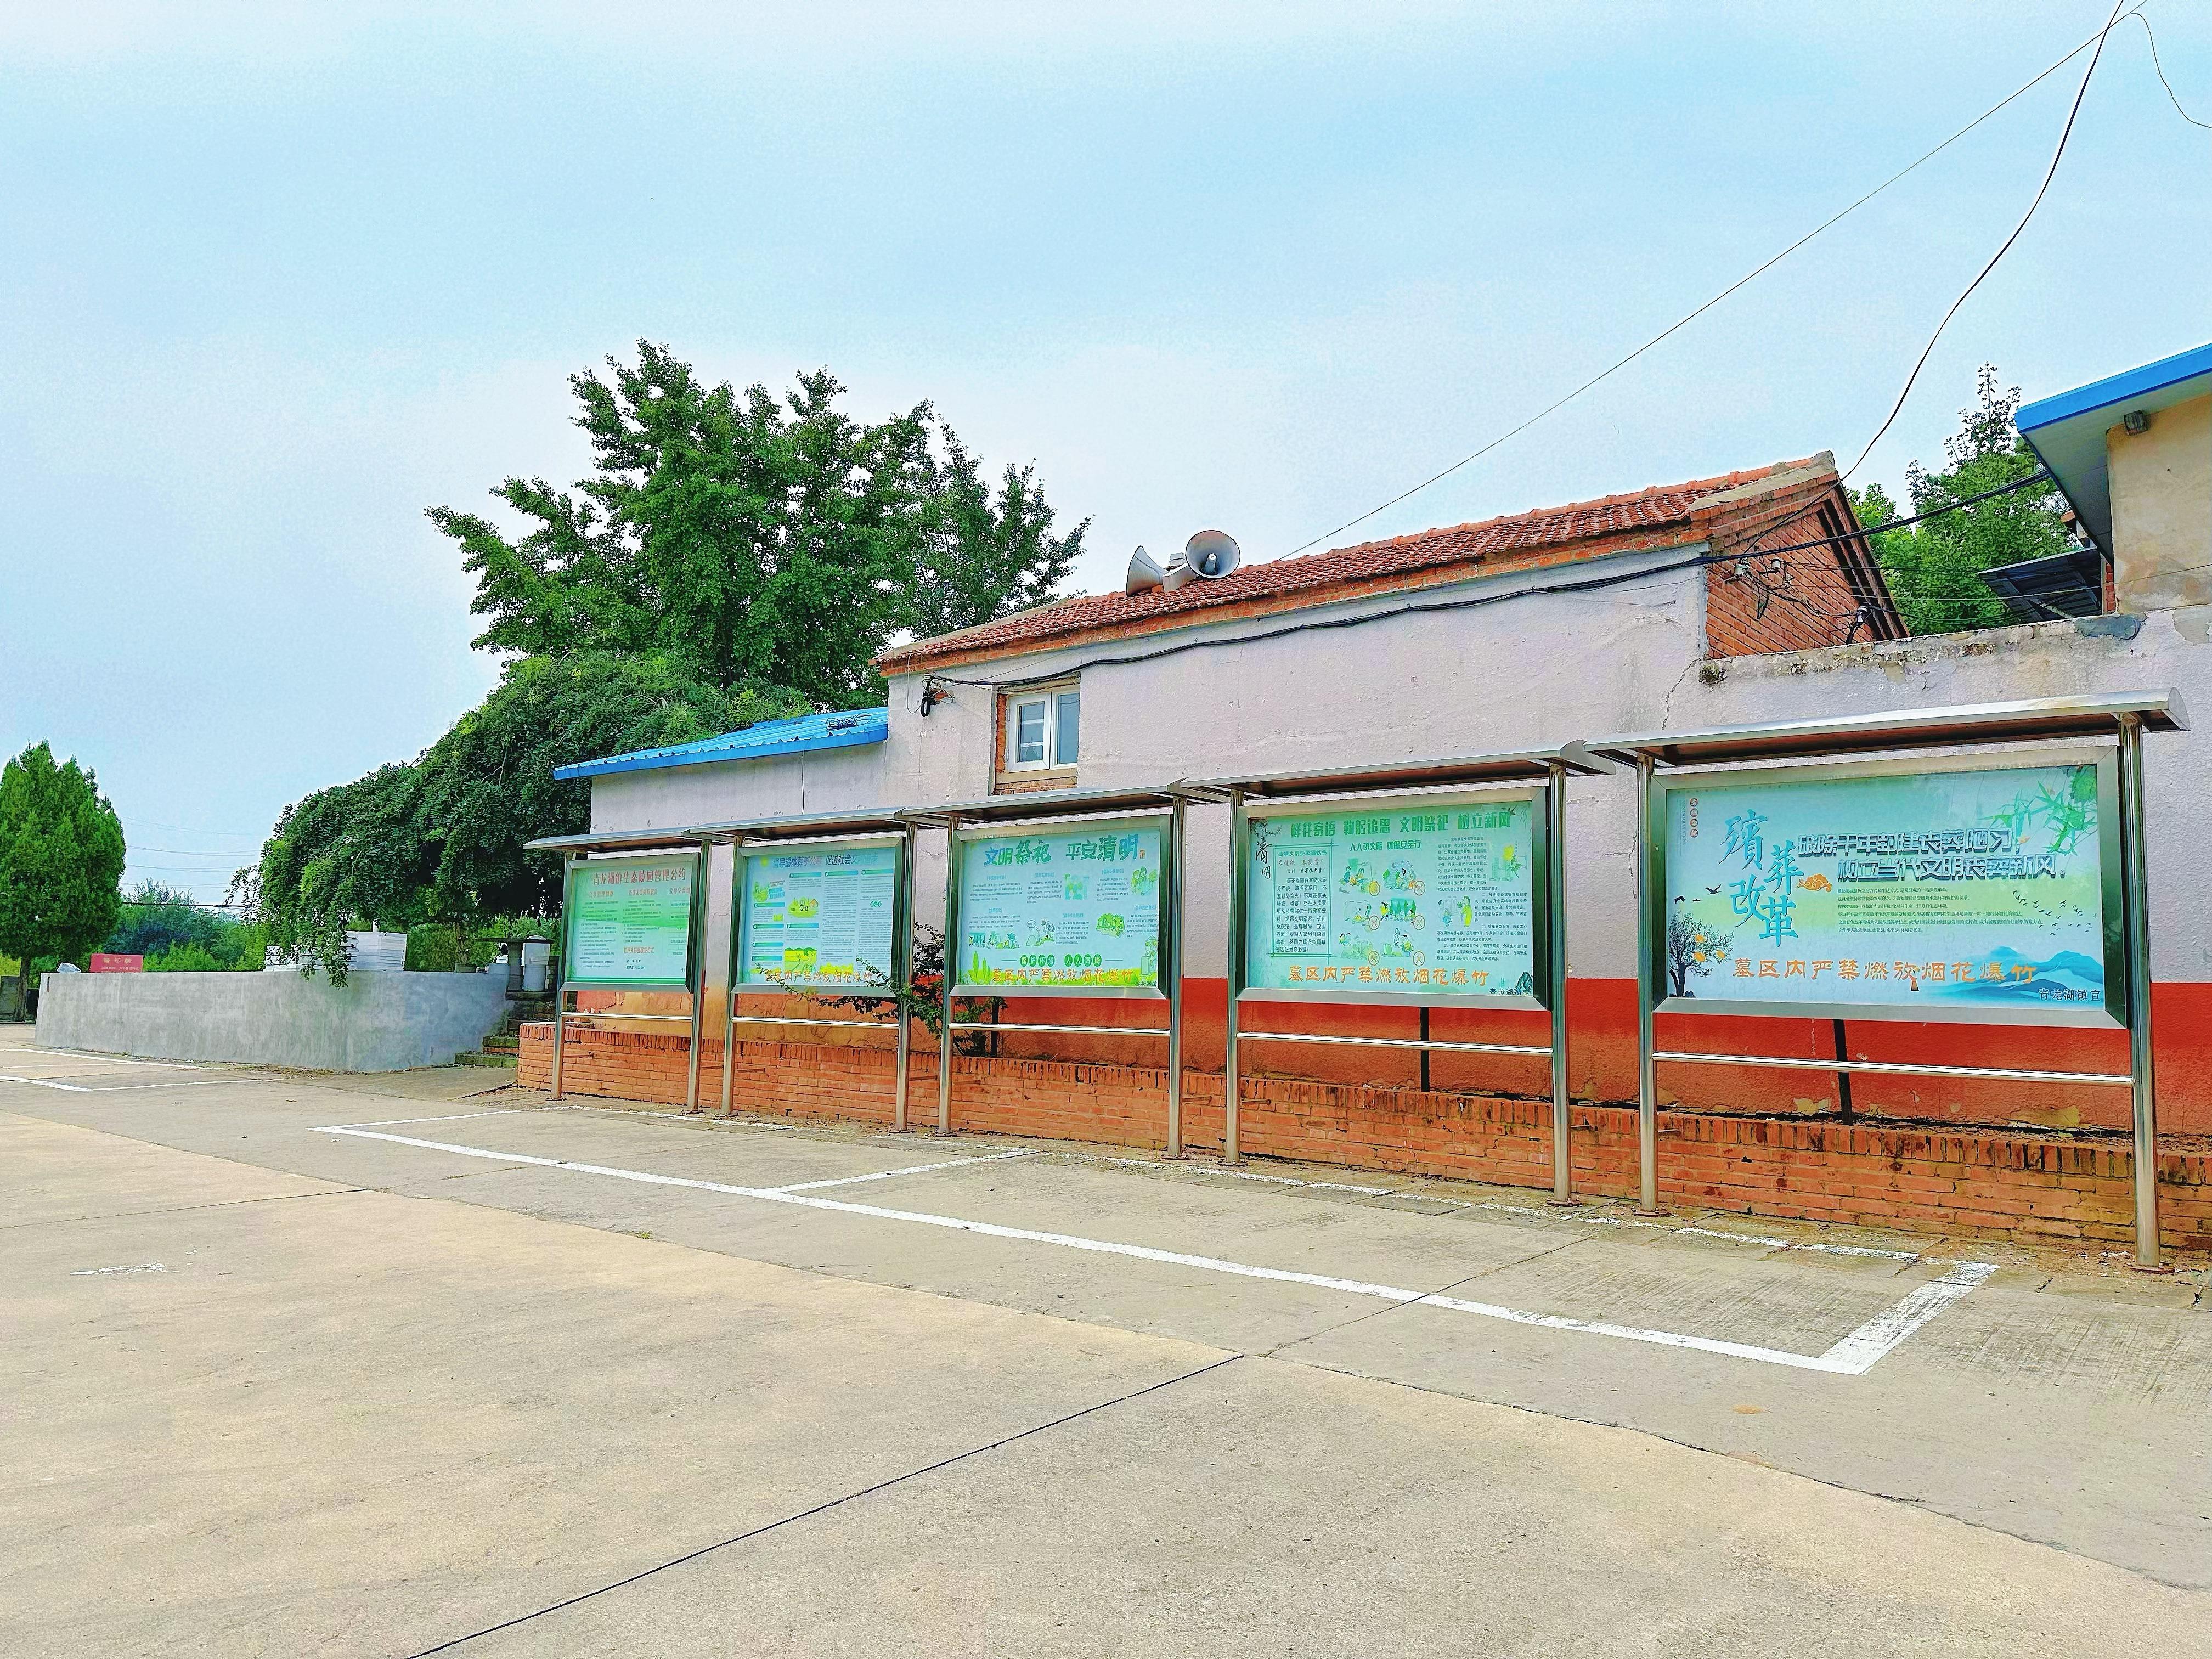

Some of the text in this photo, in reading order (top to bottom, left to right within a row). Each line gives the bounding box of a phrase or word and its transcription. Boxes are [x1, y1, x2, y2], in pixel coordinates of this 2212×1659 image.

[1290, 811, 1510, 838] 鲜花寄语 鞠躬追思 文明祭祀 树立新风
[984, 833, 1139, 866] 文明祭祀 平安清明
[1256, 836, 1272, 879] 清明
[1350, 840, 1421, 851] 人人讲文明 环保安全行
[1288, 966, 1490, 986] 墓区内严禁燃放烟花爆竹
[1732, 958, 2037, 984] 墓区内严禁燃放烟花爆竹
[2038, 988, 2101, 1002] 青龙湖镇宣
